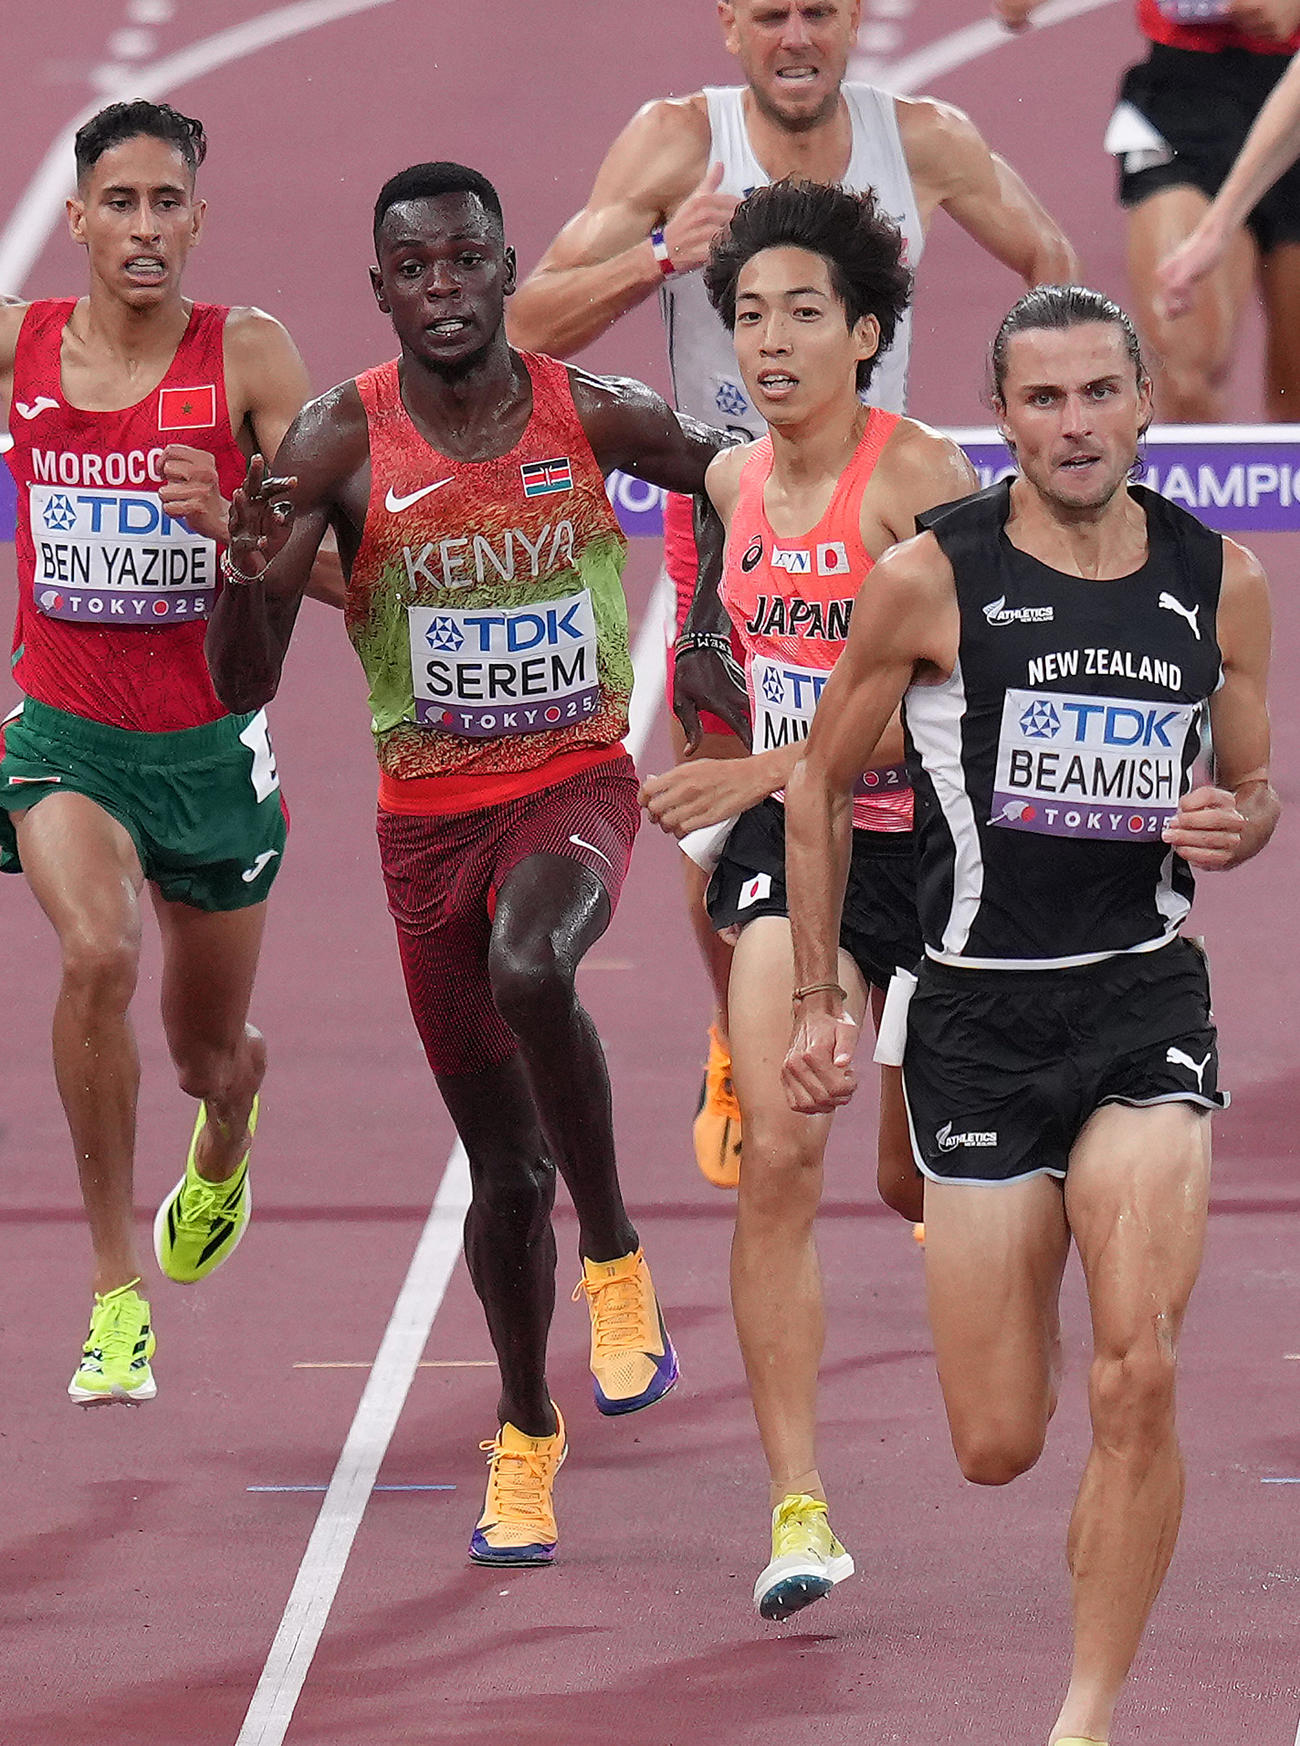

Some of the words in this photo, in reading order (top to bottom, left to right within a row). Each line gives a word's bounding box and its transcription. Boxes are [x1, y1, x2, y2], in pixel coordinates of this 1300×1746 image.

[32, 447, 165, 486] MOROCC
[41, 543, 91, 583] BEN
[102, 546, 207, 586] YAZIDE
[402, 519, 577, 592] KENYA
[463, 602, 584, 652] TDK
[745, 594, 854, 641] JAPAN
[426, 646, 586, 699] SEREM
[1028, 649, 1079, 686] NEW
[1084, 648, 1182, 691] ZEALAND
[1062, 702, 1181, 748] TDK
[1008, 749, 1173, 800] BEAMISH
[945, 1131, 998, 1147] ATHLETICS
